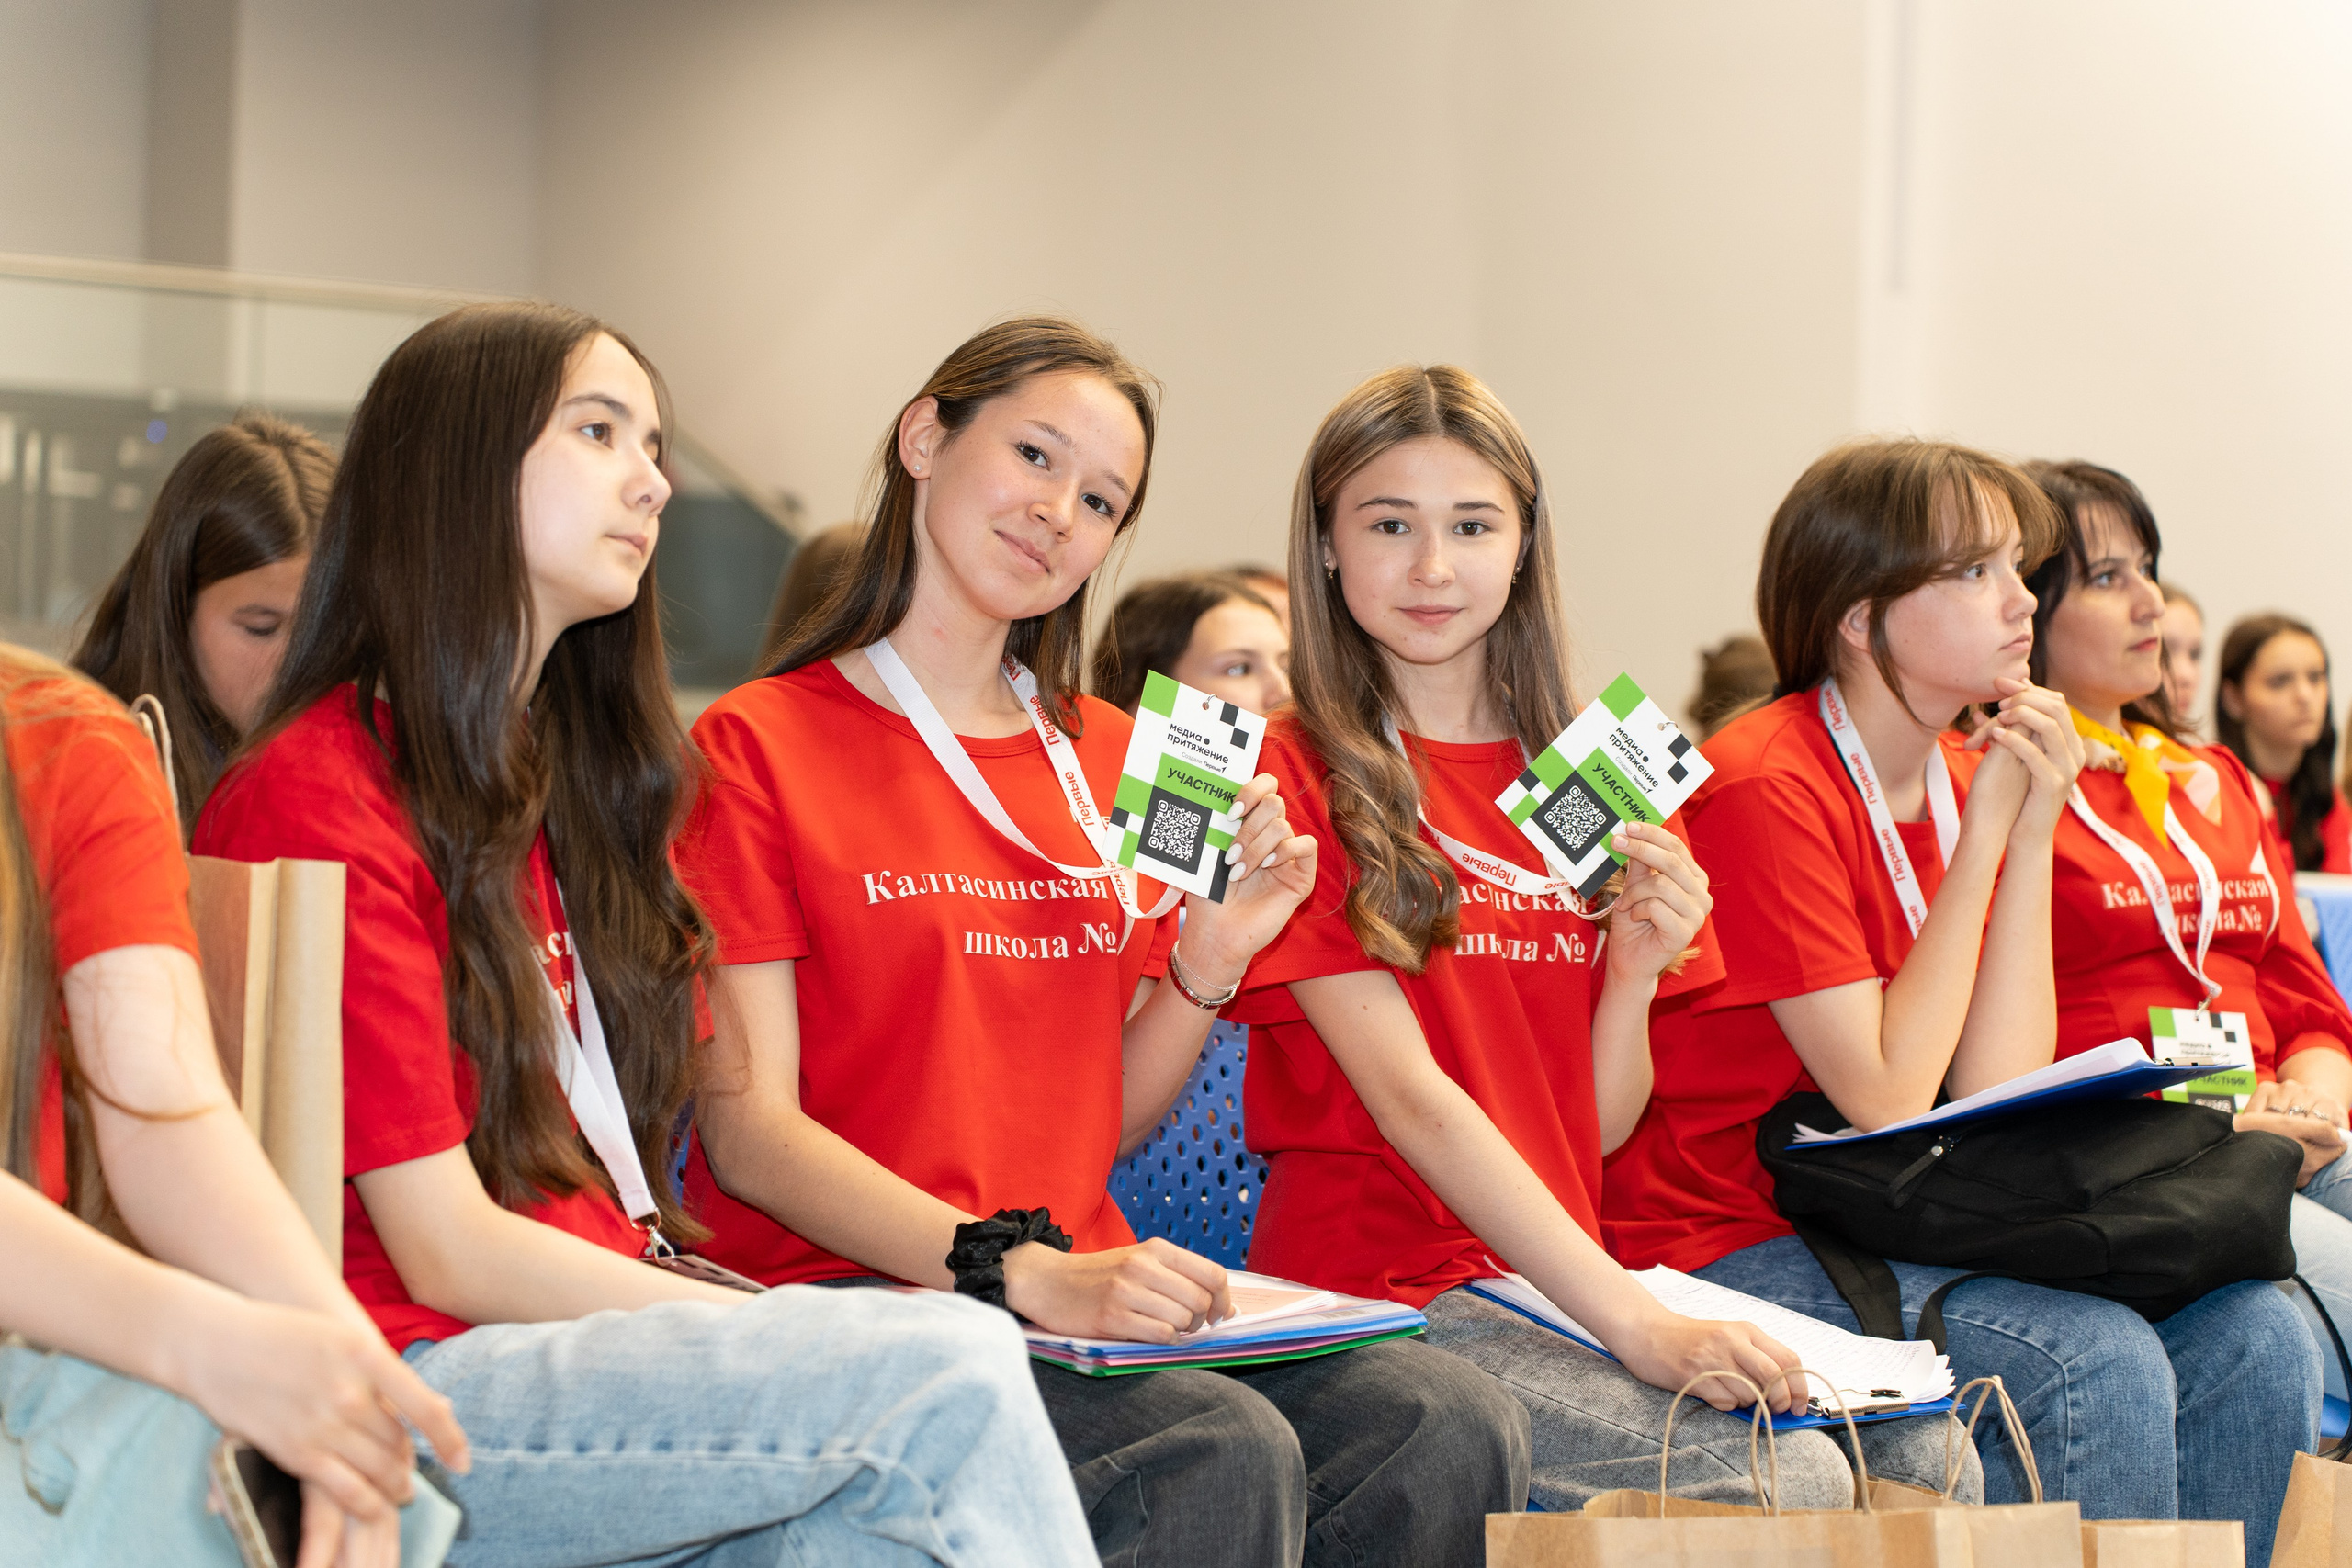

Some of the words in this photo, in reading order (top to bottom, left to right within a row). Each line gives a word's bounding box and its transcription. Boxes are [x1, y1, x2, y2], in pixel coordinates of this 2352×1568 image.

[1029, 694, 1060, 746] Первые
[1169, 723, 1203, 742] медиа
[1167, 733, 1229, 764] притяжение
[1615, 727, 1644, 757] медиа
[1609, 733, 1659, 788] притяжение
[1064, 770, 1095, 826] Первые
[1167, 767, 1238, 804] УЧАСТНИК
[1592, 762, 1651, 822] УЧАСТНИК
[1462, 852, 1517, 886] Первые
[1881, 829, 1906, 883] Первые
[861, 870, 1110, 906] Калтасинская
[963, 931, 1069, 960] школа
[1453, 932, 1540, 962] шкла
